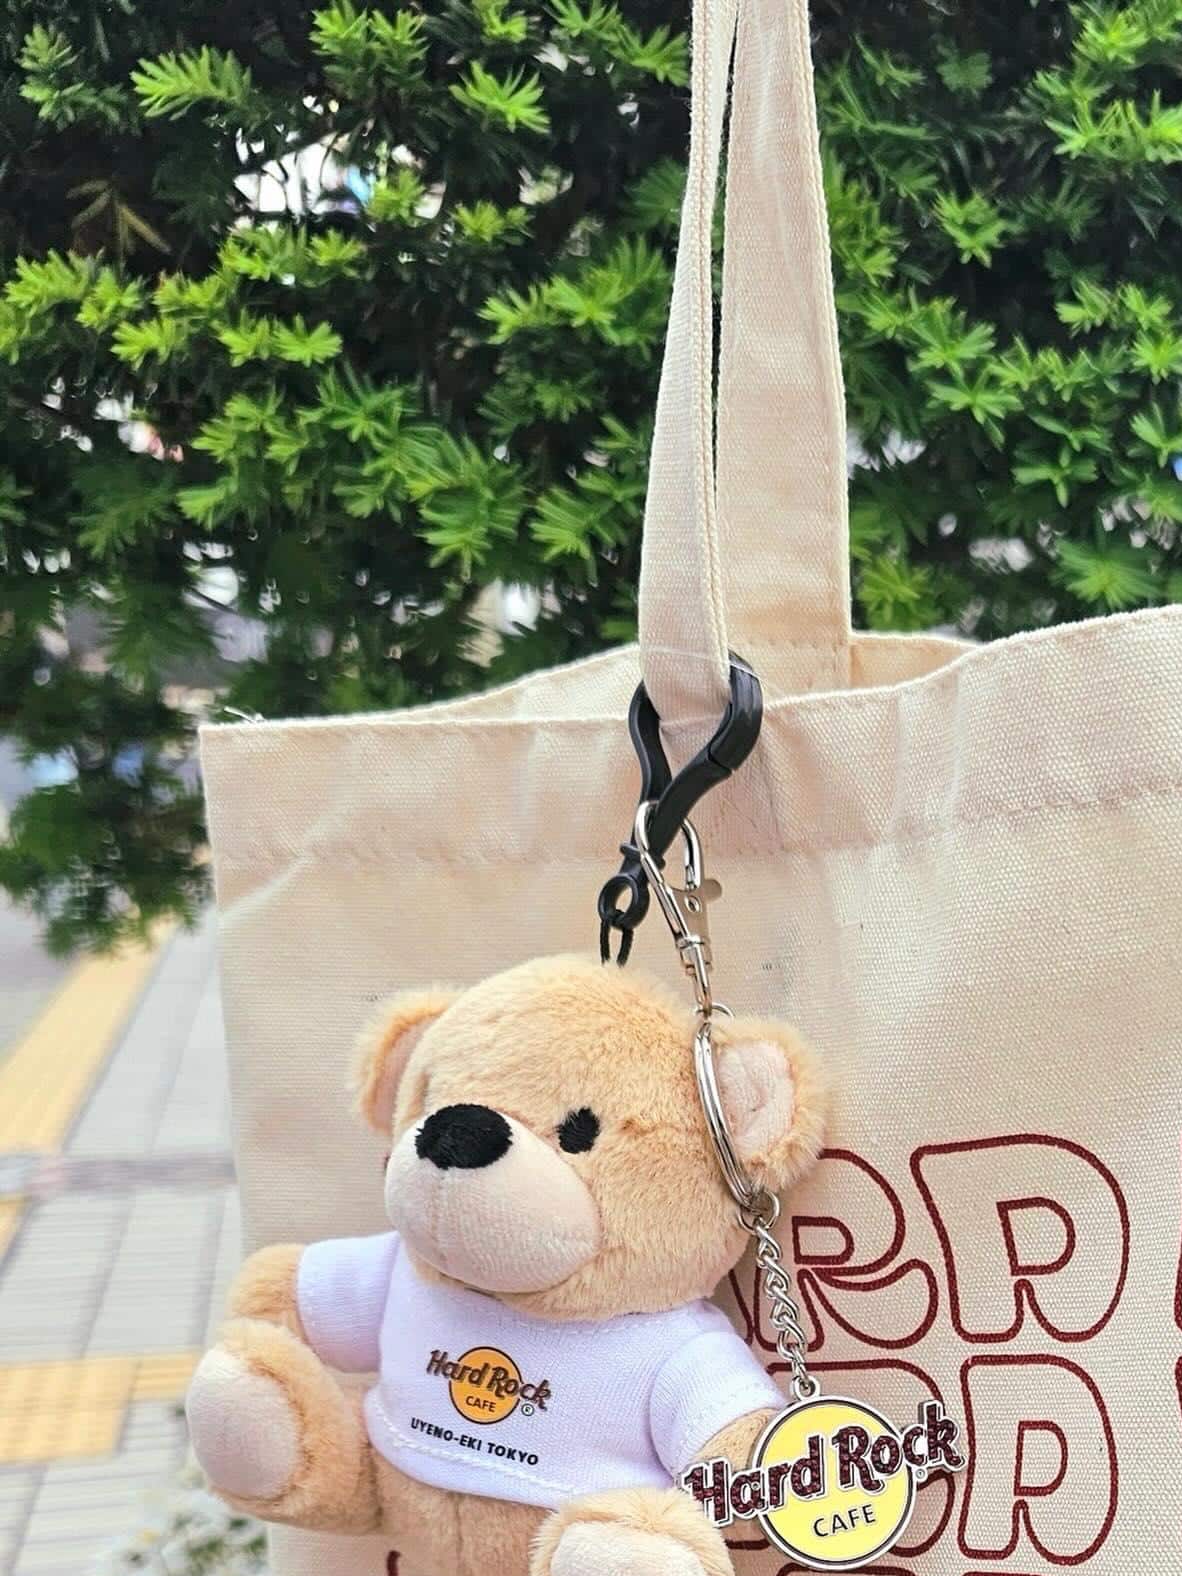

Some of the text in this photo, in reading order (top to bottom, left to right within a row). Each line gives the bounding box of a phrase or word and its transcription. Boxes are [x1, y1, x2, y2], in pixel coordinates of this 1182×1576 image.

[730, 1134, 1131, 1350] RD
[426, 1350, 552, 1411] Hard Rock
[465, 1395, 497, 1413] CAFE
[410, 1417, 539, 1466] UYENO-EKI TOKYO
[683, 1435, 825, 1526] Hard
[831, 1400, 964, 1493] Rock
[812, 1503, 876, 1538] CAFE
